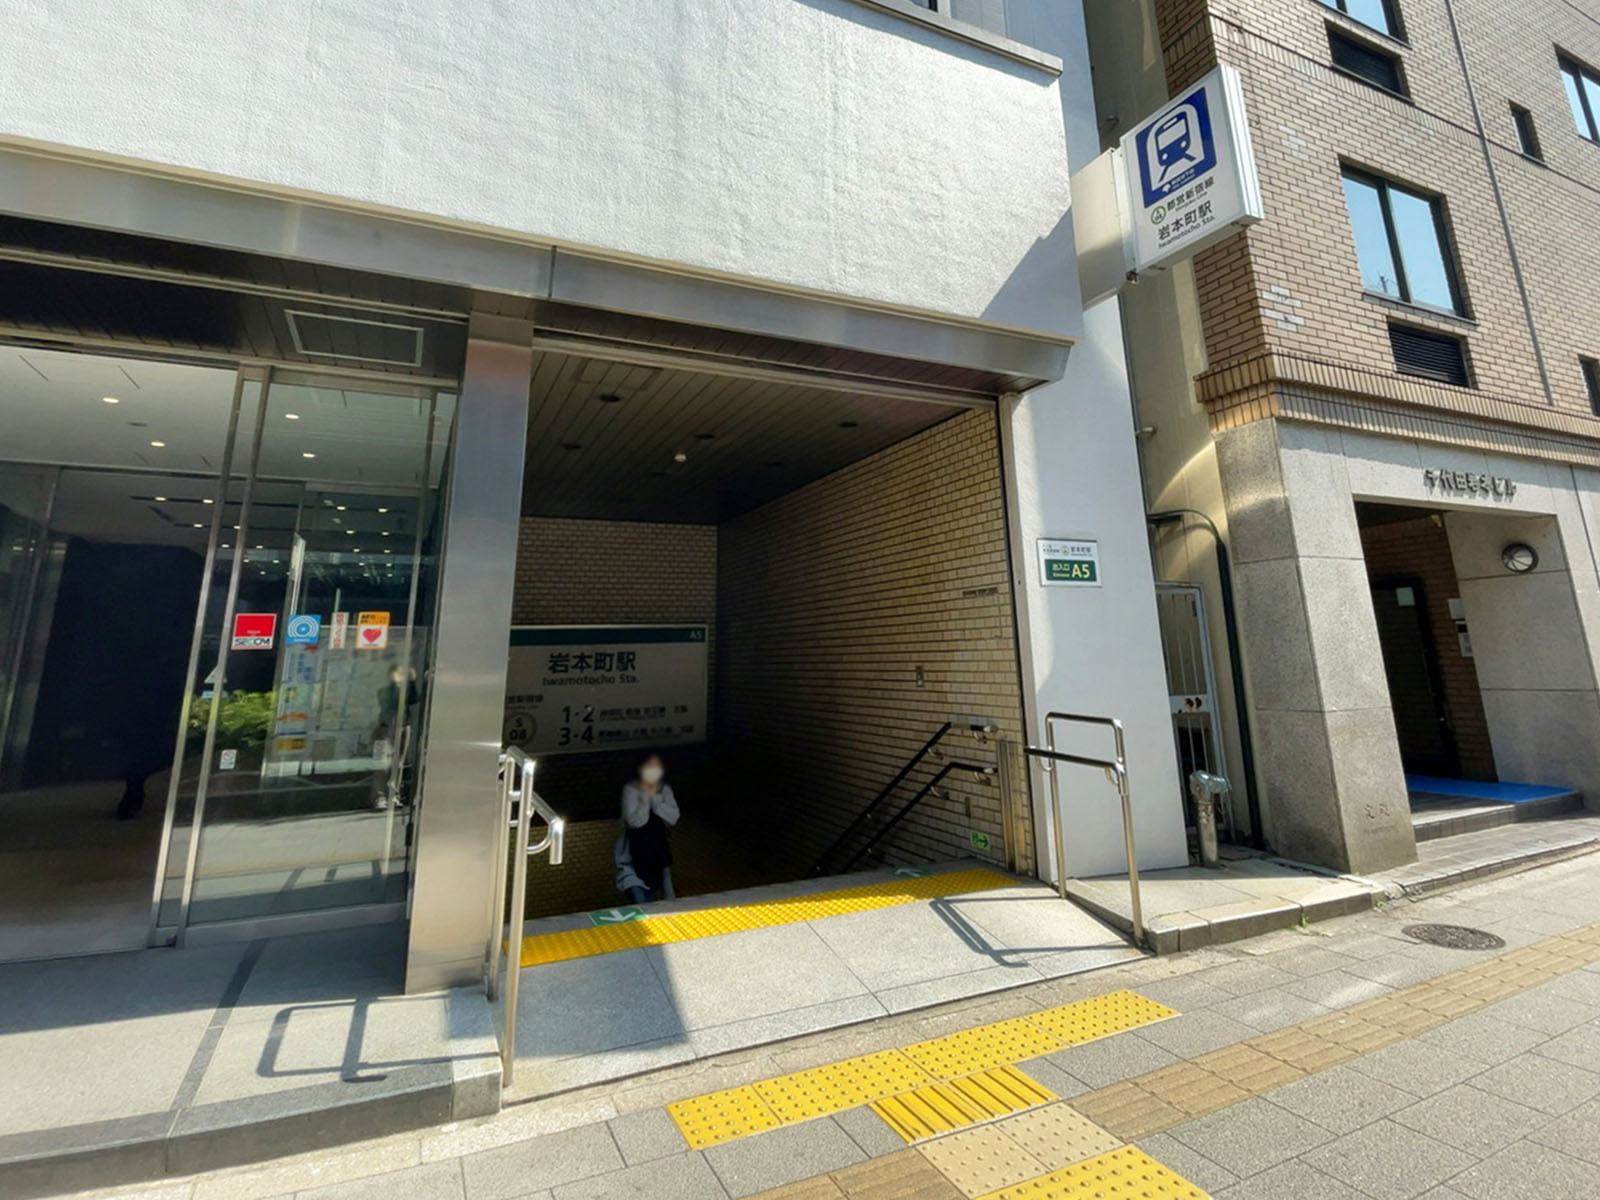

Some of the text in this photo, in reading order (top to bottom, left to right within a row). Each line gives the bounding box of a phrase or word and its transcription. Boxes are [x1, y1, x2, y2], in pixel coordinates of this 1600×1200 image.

[1158, 200, 1212, 240] 岩本町駅
[1071, 563, 1090, 578] A5
[689, 628, 703, 640] A5
[548, 651, 637, 674] 岩本町駅
[542, 672, 640, 687] Iwamotocho Sta.
